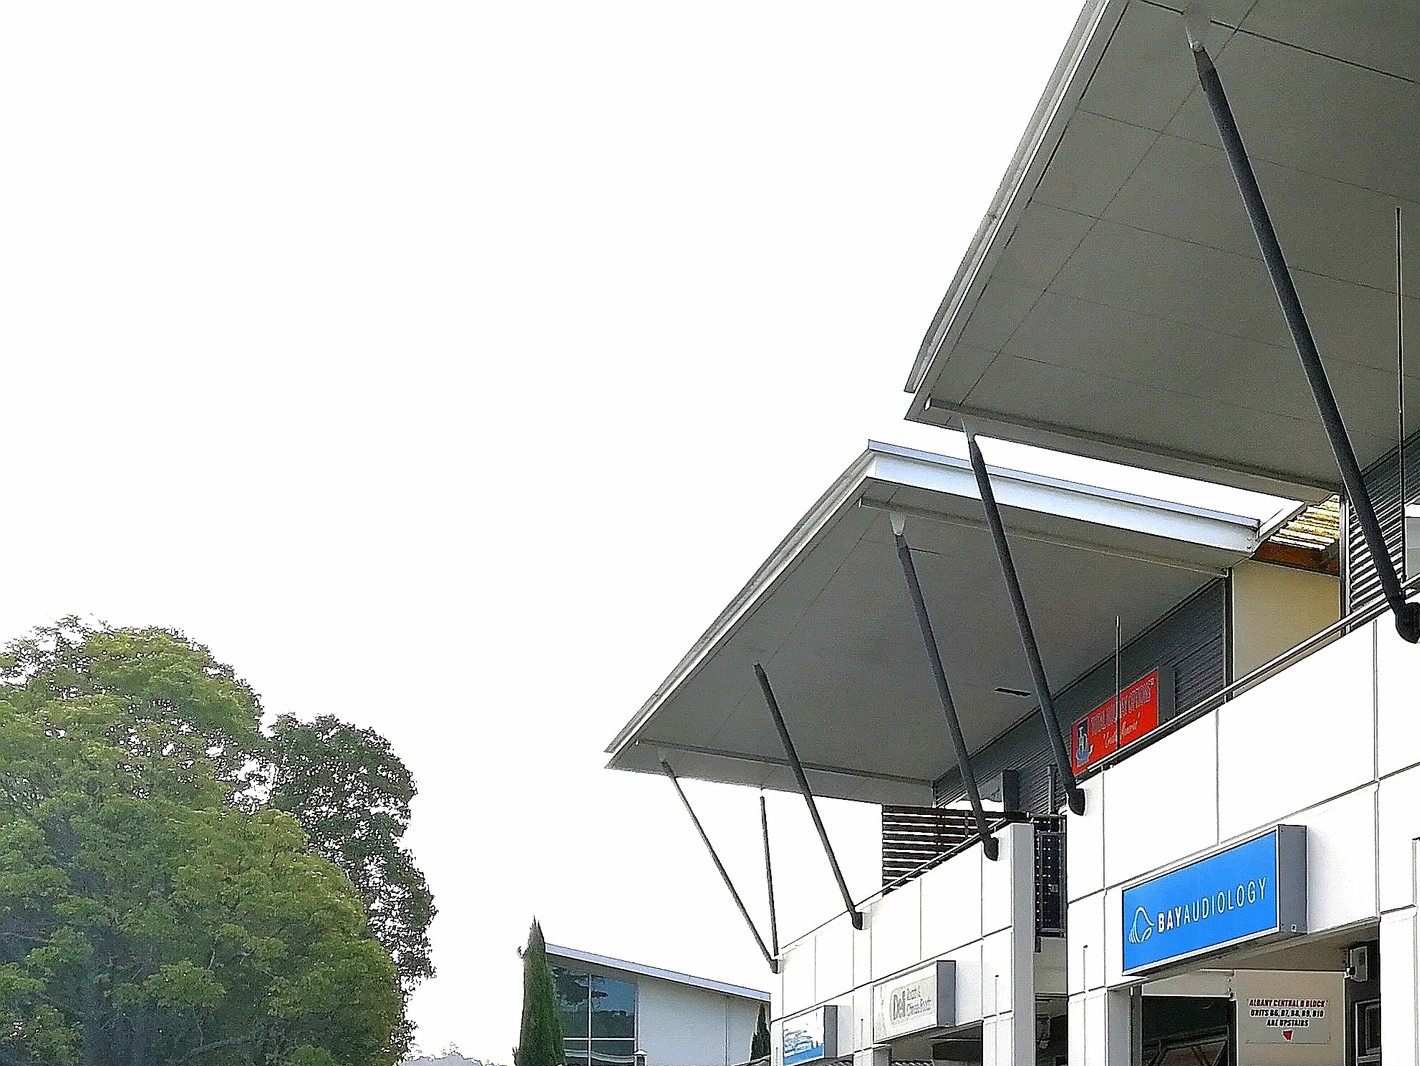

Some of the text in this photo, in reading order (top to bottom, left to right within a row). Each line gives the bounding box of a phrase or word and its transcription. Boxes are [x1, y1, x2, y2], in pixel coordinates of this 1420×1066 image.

[1249, 999, 1273, 1007] ALBANY
[1274, 999, 1299, 1007] CENTRAL
[1306, 1000, 1325, 1008] BLOCK
[1250, 1009, 1269, 1017] UNITS
[1266, 1019, 1309, 1027] ARE UPSTAIRS
